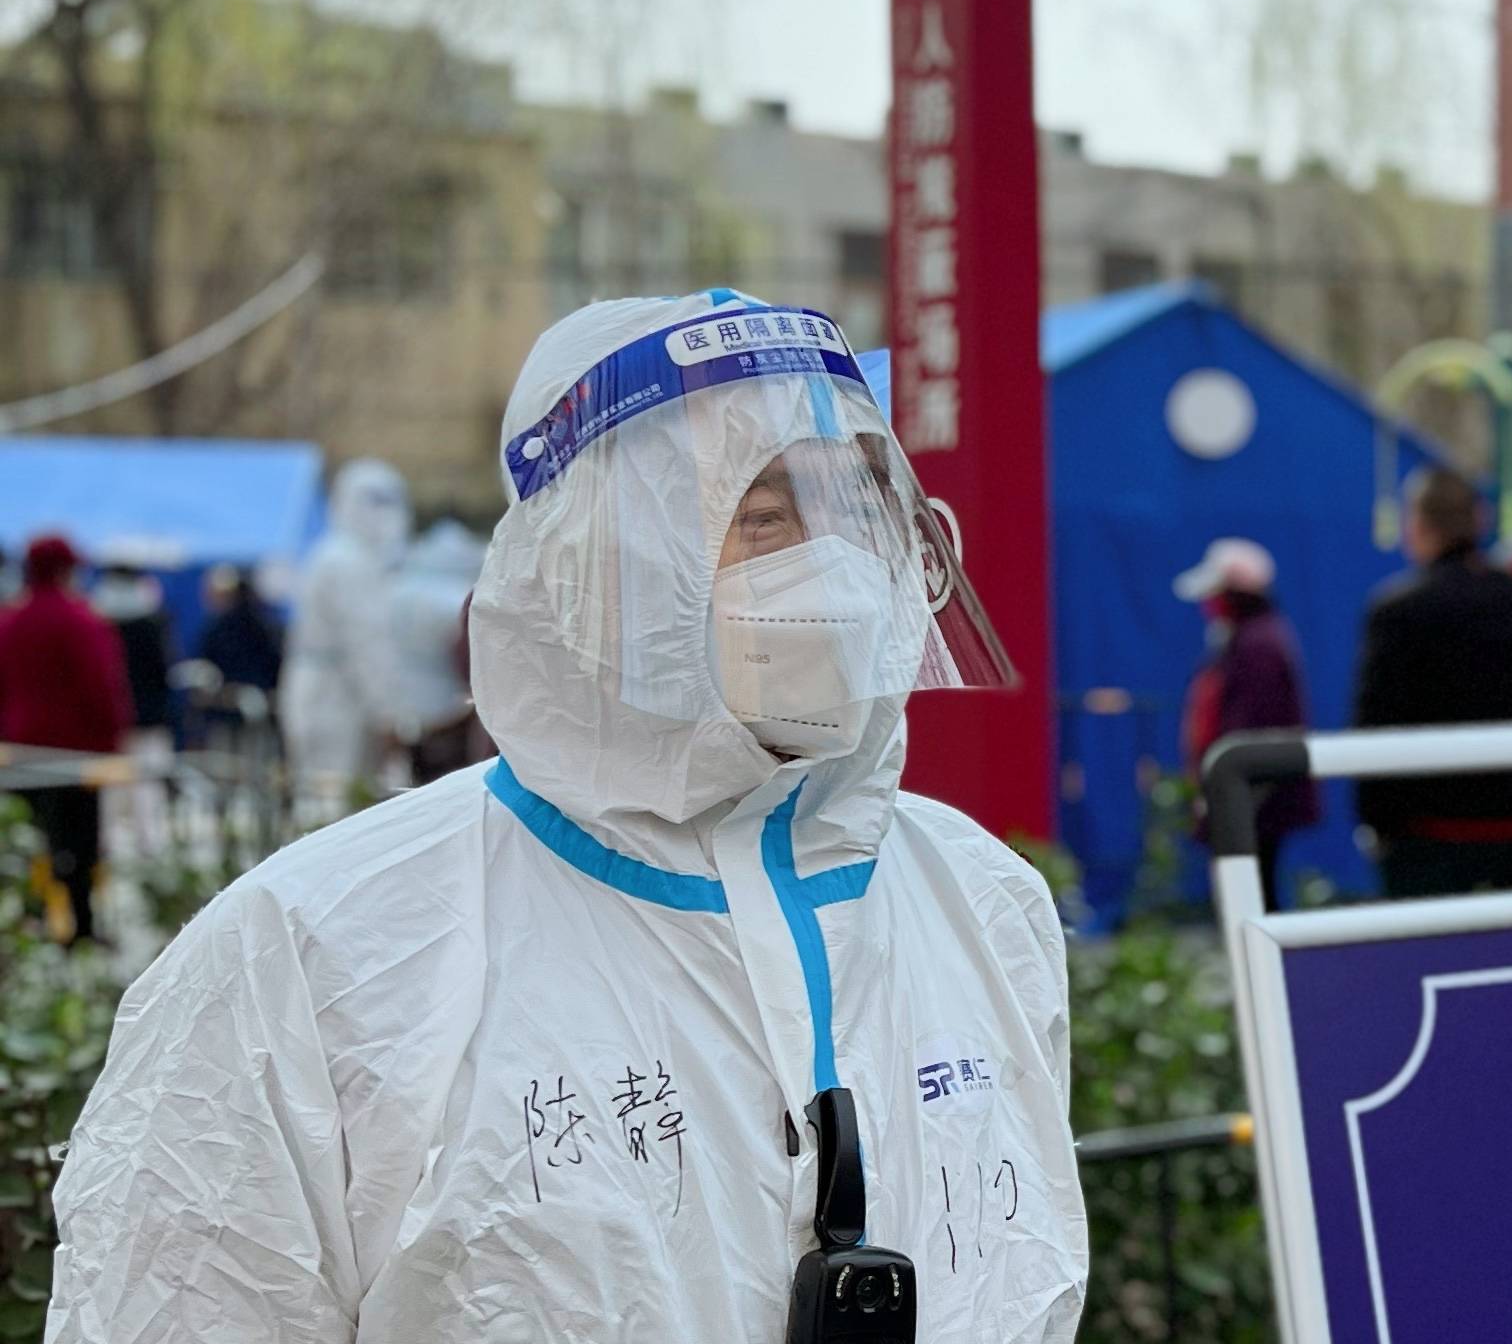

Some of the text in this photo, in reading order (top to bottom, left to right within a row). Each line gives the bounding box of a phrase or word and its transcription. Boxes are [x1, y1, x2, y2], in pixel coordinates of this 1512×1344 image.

[682, 315, 837, 352] 医用隔离面罩
